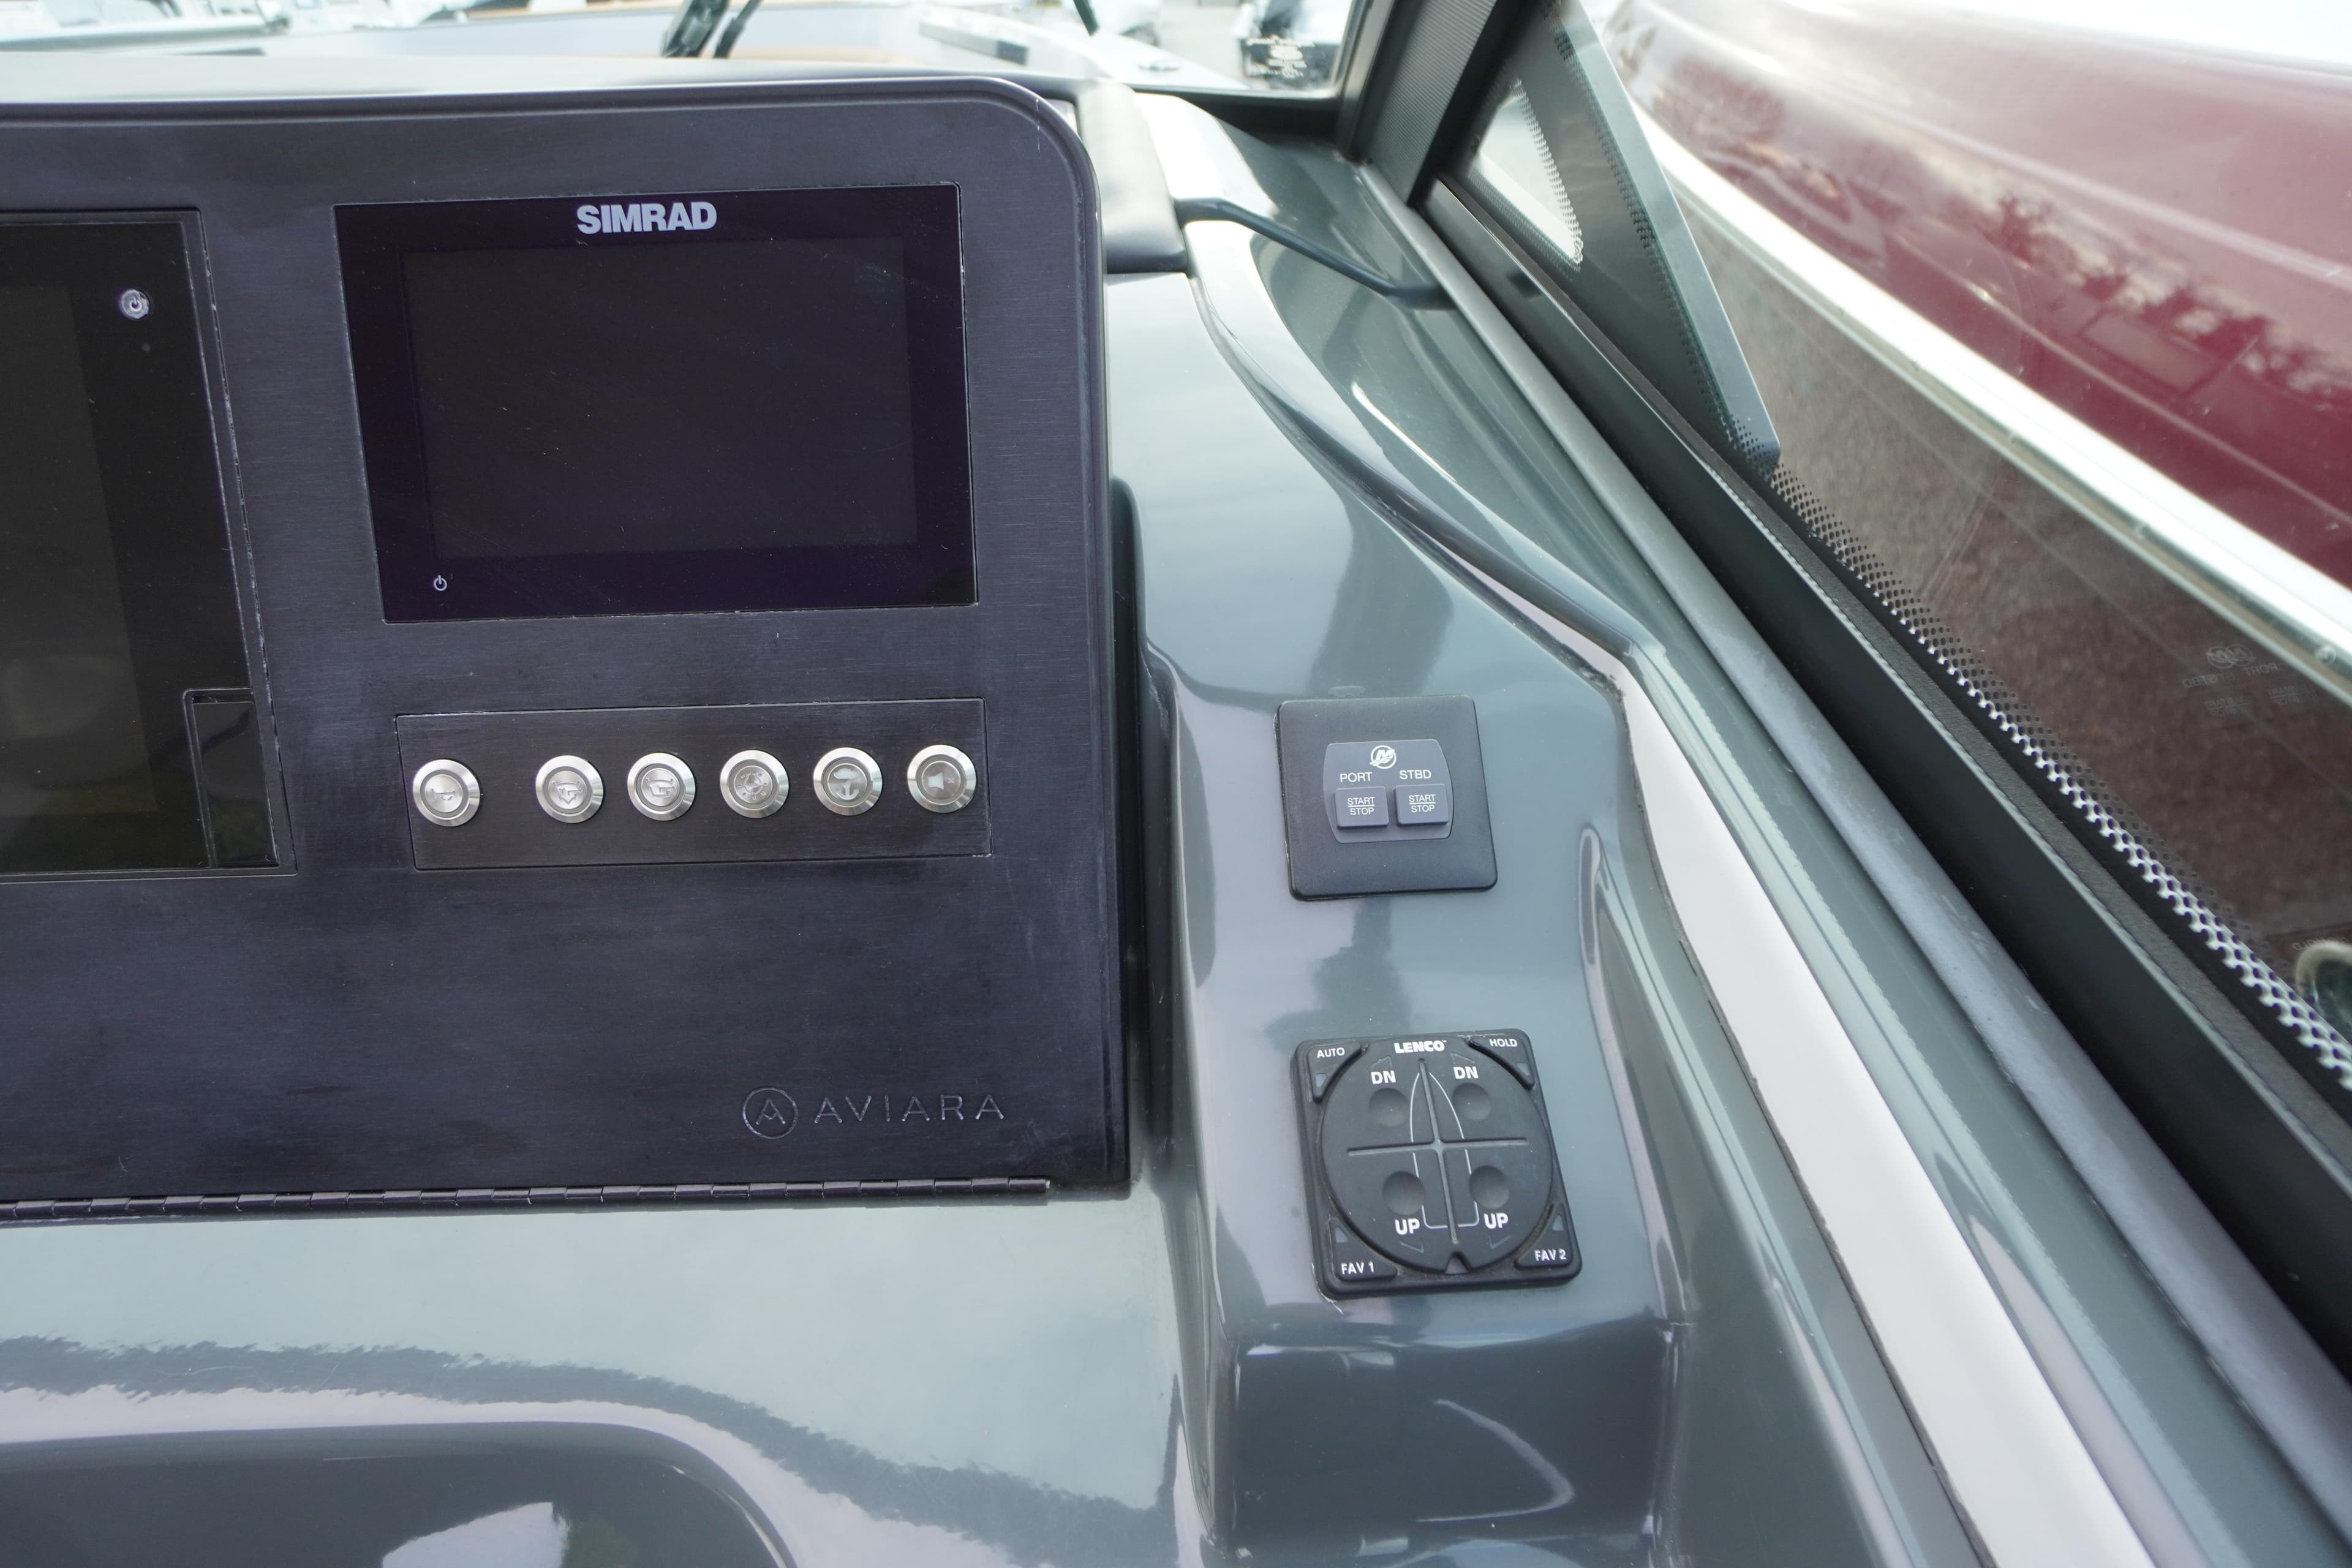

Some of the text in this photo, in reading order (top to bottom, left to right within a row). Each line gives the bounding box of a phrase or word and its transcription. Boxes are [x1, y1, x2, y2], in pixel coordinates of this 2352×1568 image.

[577, 202, 717, 234] SIMRAD
[1340, 772, 1373, 783] PORT
[1399, 769, 1431, 780] STBD
[1348, 797, 1376, 805] START
[1409, 794, 1436, 802] START
[1350, 807, 1374, 816] STOP
[1393, 1040, 1446, 1054] LENCO
[1489, 1038, 1518, 1047] HOLD
[1317, 1047, 1346, 1058] AUTO
[1370, 1070, 1396, 1085] DN
[1453, 1066, 1479, 1079] DN
[814, 1094, 1005, 1123] AVIARA
[1394, 1218, 1420, 1235] UP
[1483, 1213, 1509, 1229] UP
[1534, 1248, 1567, 1262] FAV 2
[1341, 1261, 1374, 1275] FAV 1
